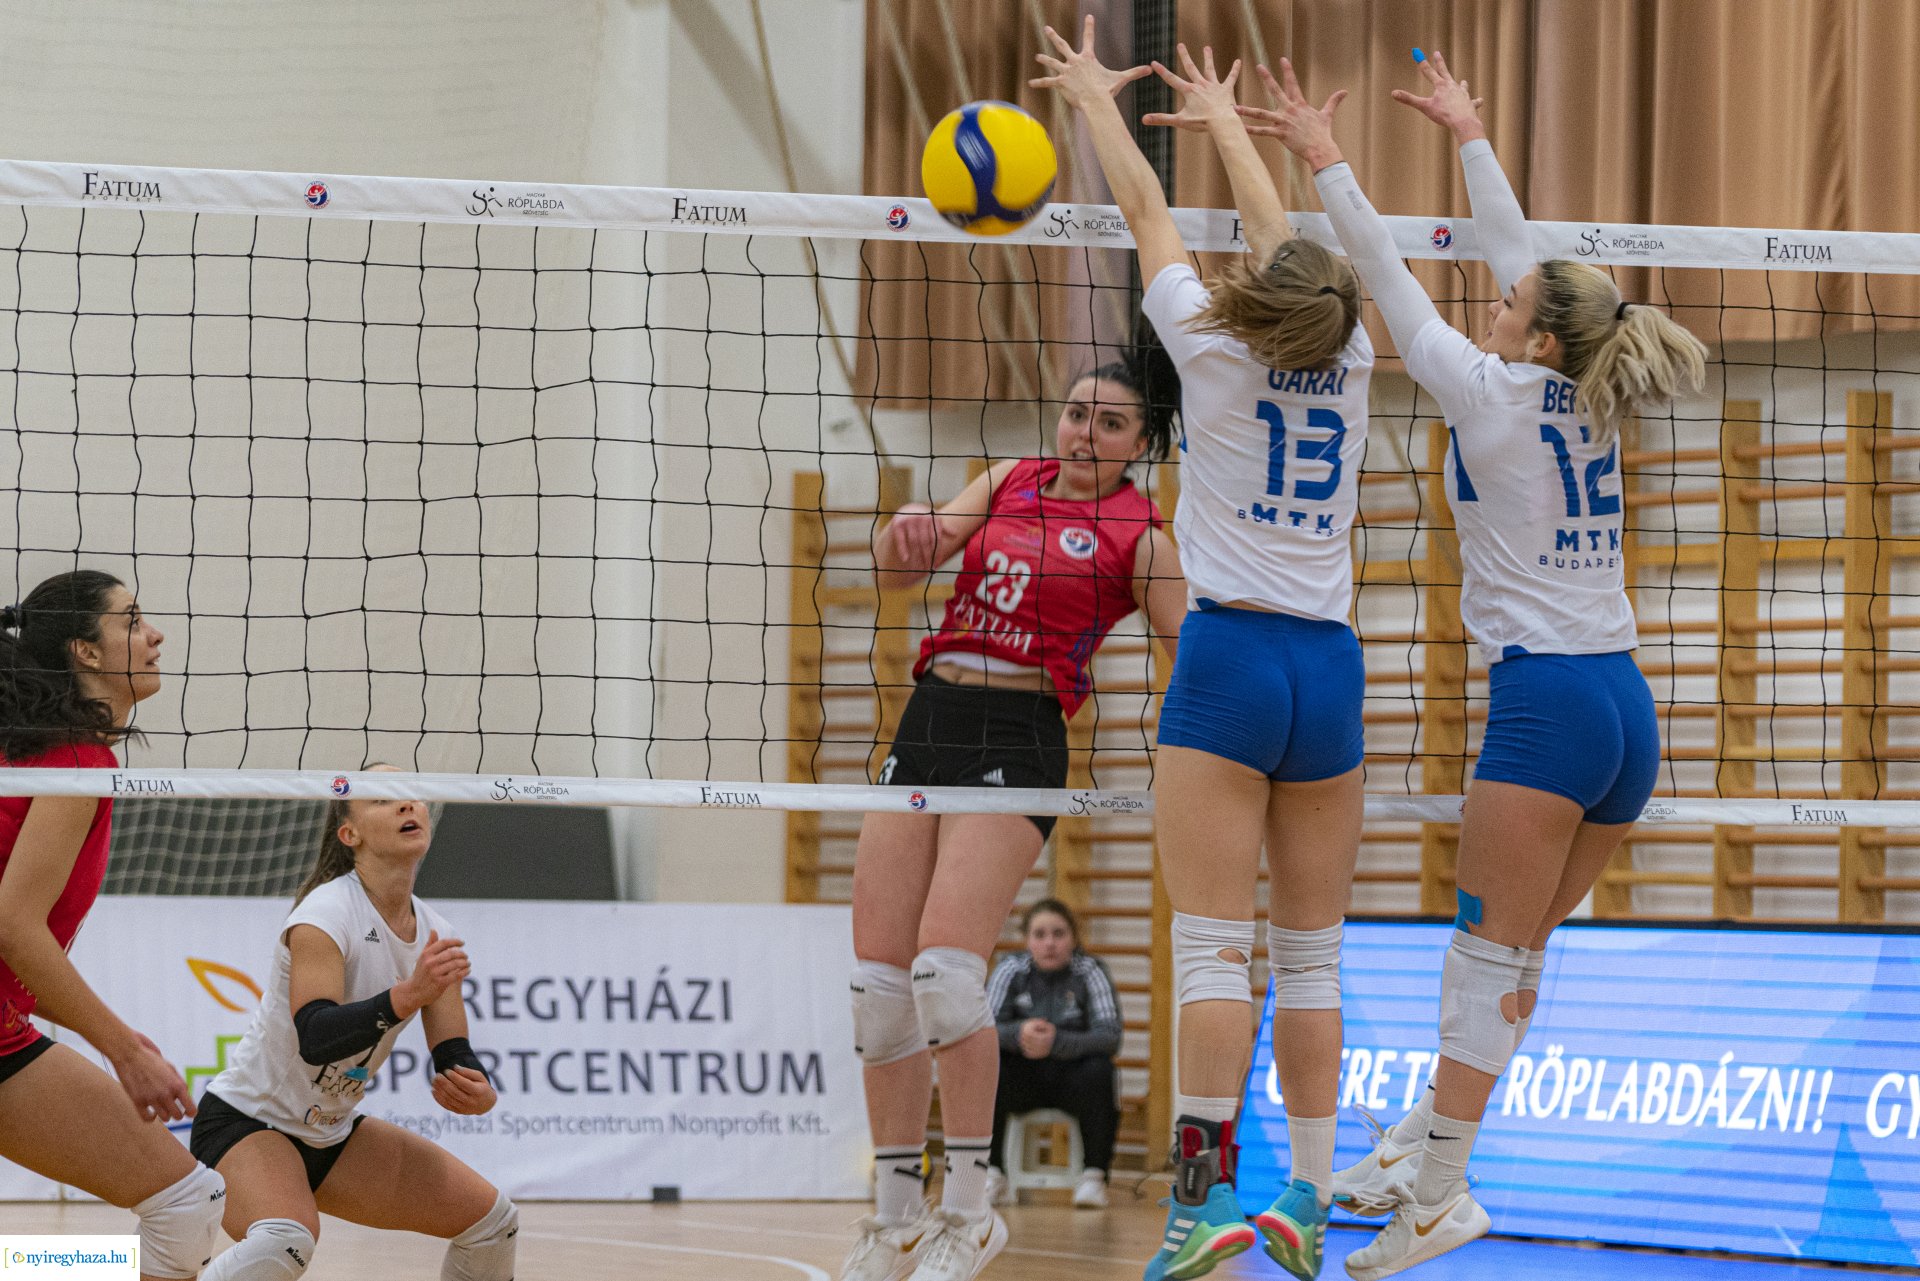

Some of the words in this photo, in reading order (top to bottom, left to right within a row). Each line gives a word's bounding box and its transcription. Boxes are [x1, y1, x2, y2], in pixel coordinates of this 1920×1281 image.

[82, 171, 162, 198] FATUM
[671, 196, 748, 222] FATUM
[1084, 219, 1130, 231] RÖPLABD
[1764, 236, 1833, 260] FATUM
[1255, 399, 1348, 501] 13
[1539, 423, 1621, 518] 12
[1251, 502, 1335, 530] MTK
[1555, 527, 1619, 552] MTK
[1539, 554, 1620, 570] BUDAPE
[975, 550, 1032, 614] 23
[111, 773, 175, 792] FATUM
[698, 785, 762, 804] FATUM
[1640, 807, 1678, 815] PLABDA
[1790, 804, 1849, 822] FATUM
[462, 965, 733, 1023] REGYHÁZI
[363, 1049, 827, 1096] PRTCENTRUM
[1501, 1044, 1834, 1135] RÖPLABDÁZNI!
[500, 1111, 664, 1140] Sportcentrum
[671, 1110, 783, 1140] Nonprofit
[788, 1112, 831, 1136] Kft.
